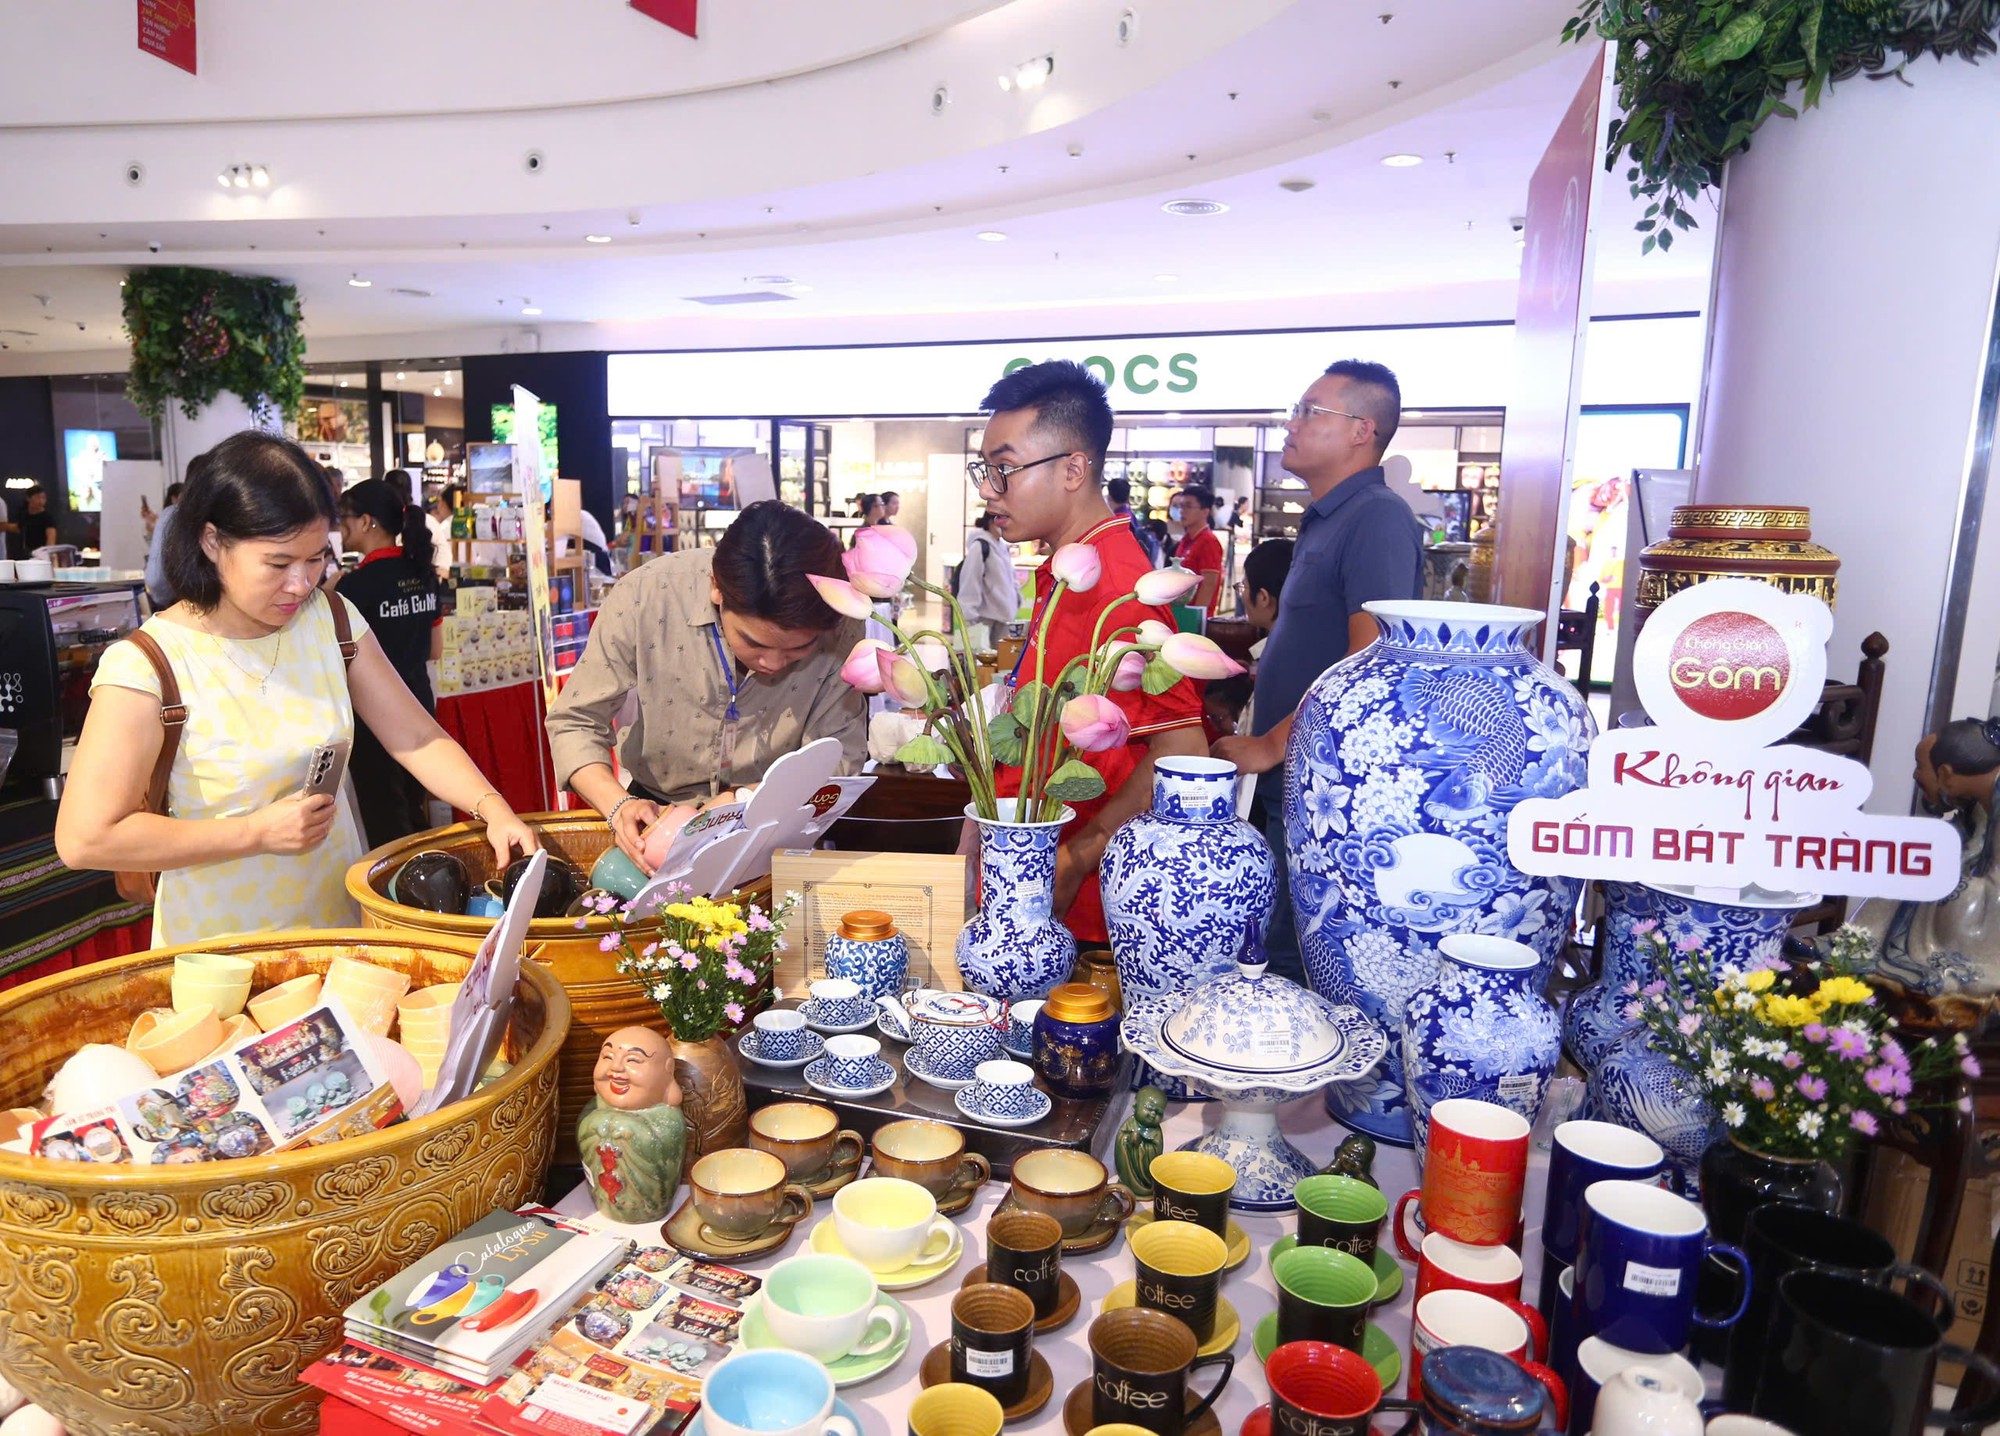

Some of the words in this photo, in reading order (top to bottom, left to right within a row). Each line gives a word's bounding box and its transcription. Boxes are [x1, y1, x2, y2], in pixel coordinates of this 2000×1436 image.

[379, 598, 410, 618] Café
[1613, 750, 1755, 821] Không
[1763, 770, 1845, 822] gian
[1531, 812, 1634, 858] GỐM
[1652, 824, 1746, 865] BÁT
[1764, 832, 1933, 877] TRÀNG
[455, 1221, 536, 1276] Catalogue
